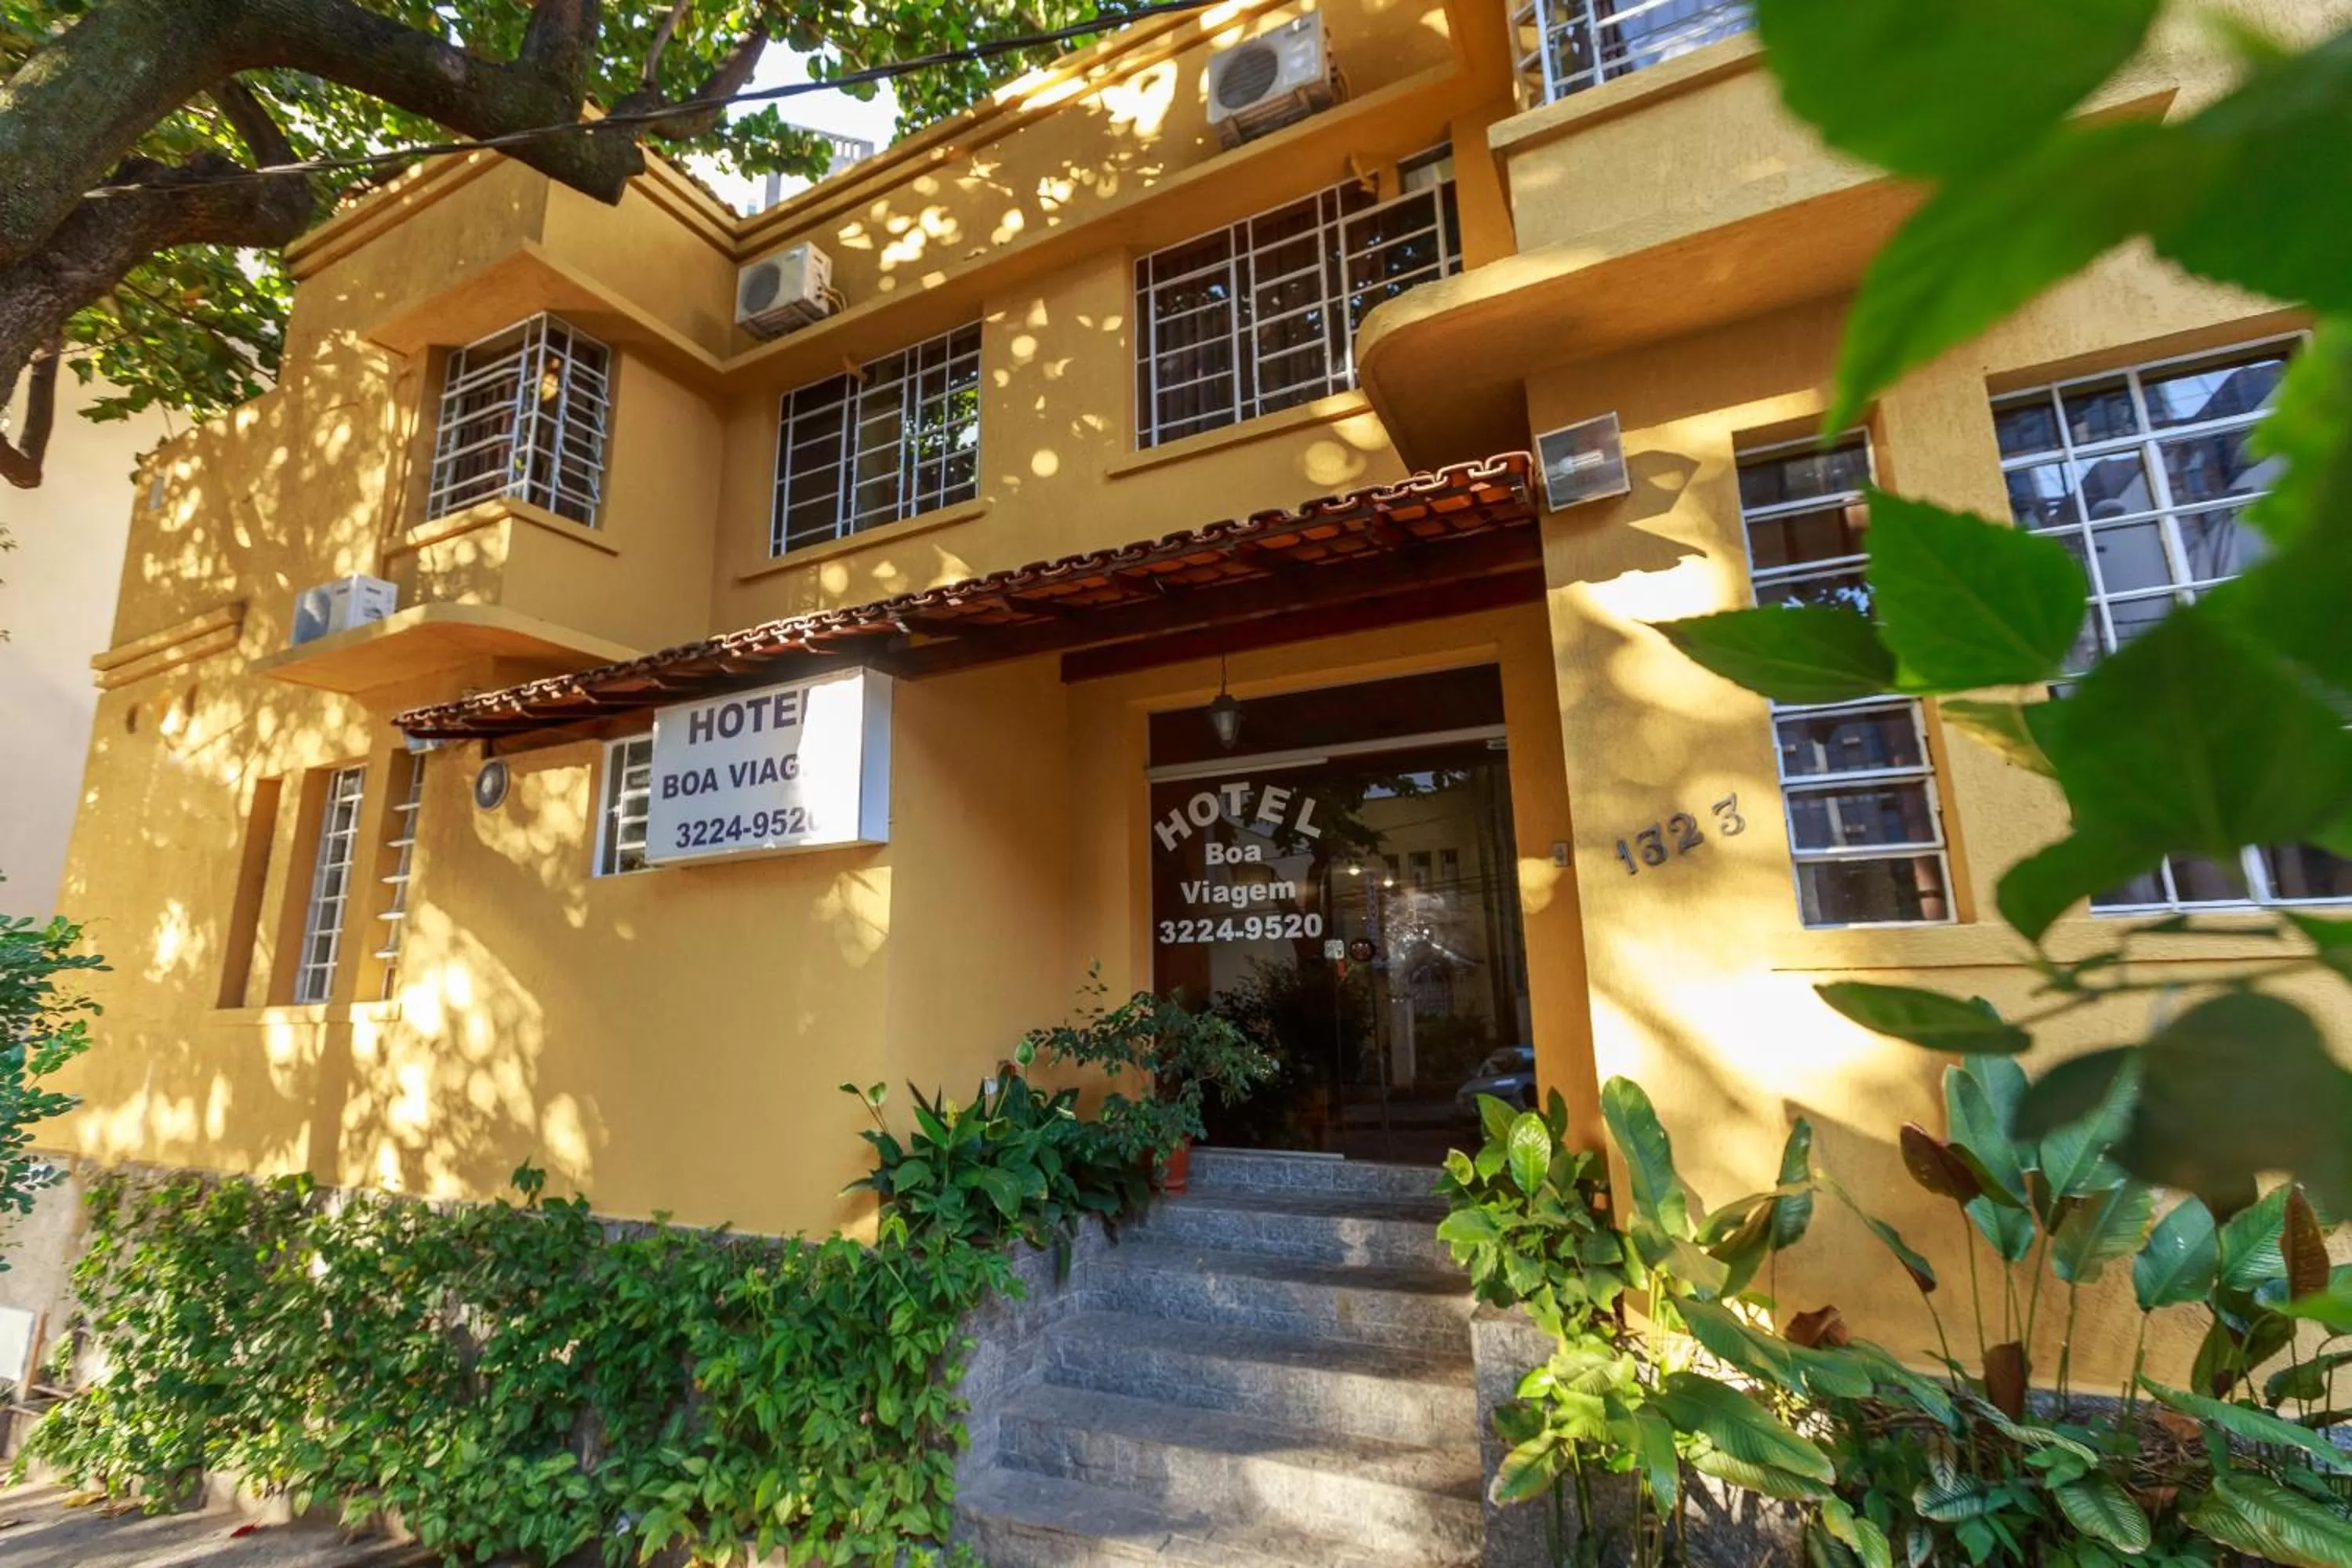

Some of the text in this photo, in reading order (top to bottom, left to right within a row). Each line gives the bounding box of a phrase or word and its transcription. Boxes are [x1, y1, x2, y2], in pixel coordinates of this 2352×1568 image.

[662, 753, 801, 800] BOA VIAG
[1154, 782, 1321, 851] HOTEL
[1616, 791, 1746, 875] 1323
[1205, 843, 1261, 865] Boa
[1180, 880, 1296, 909] Viagem
[1159, 913, 1323, 944] 3224-9520
